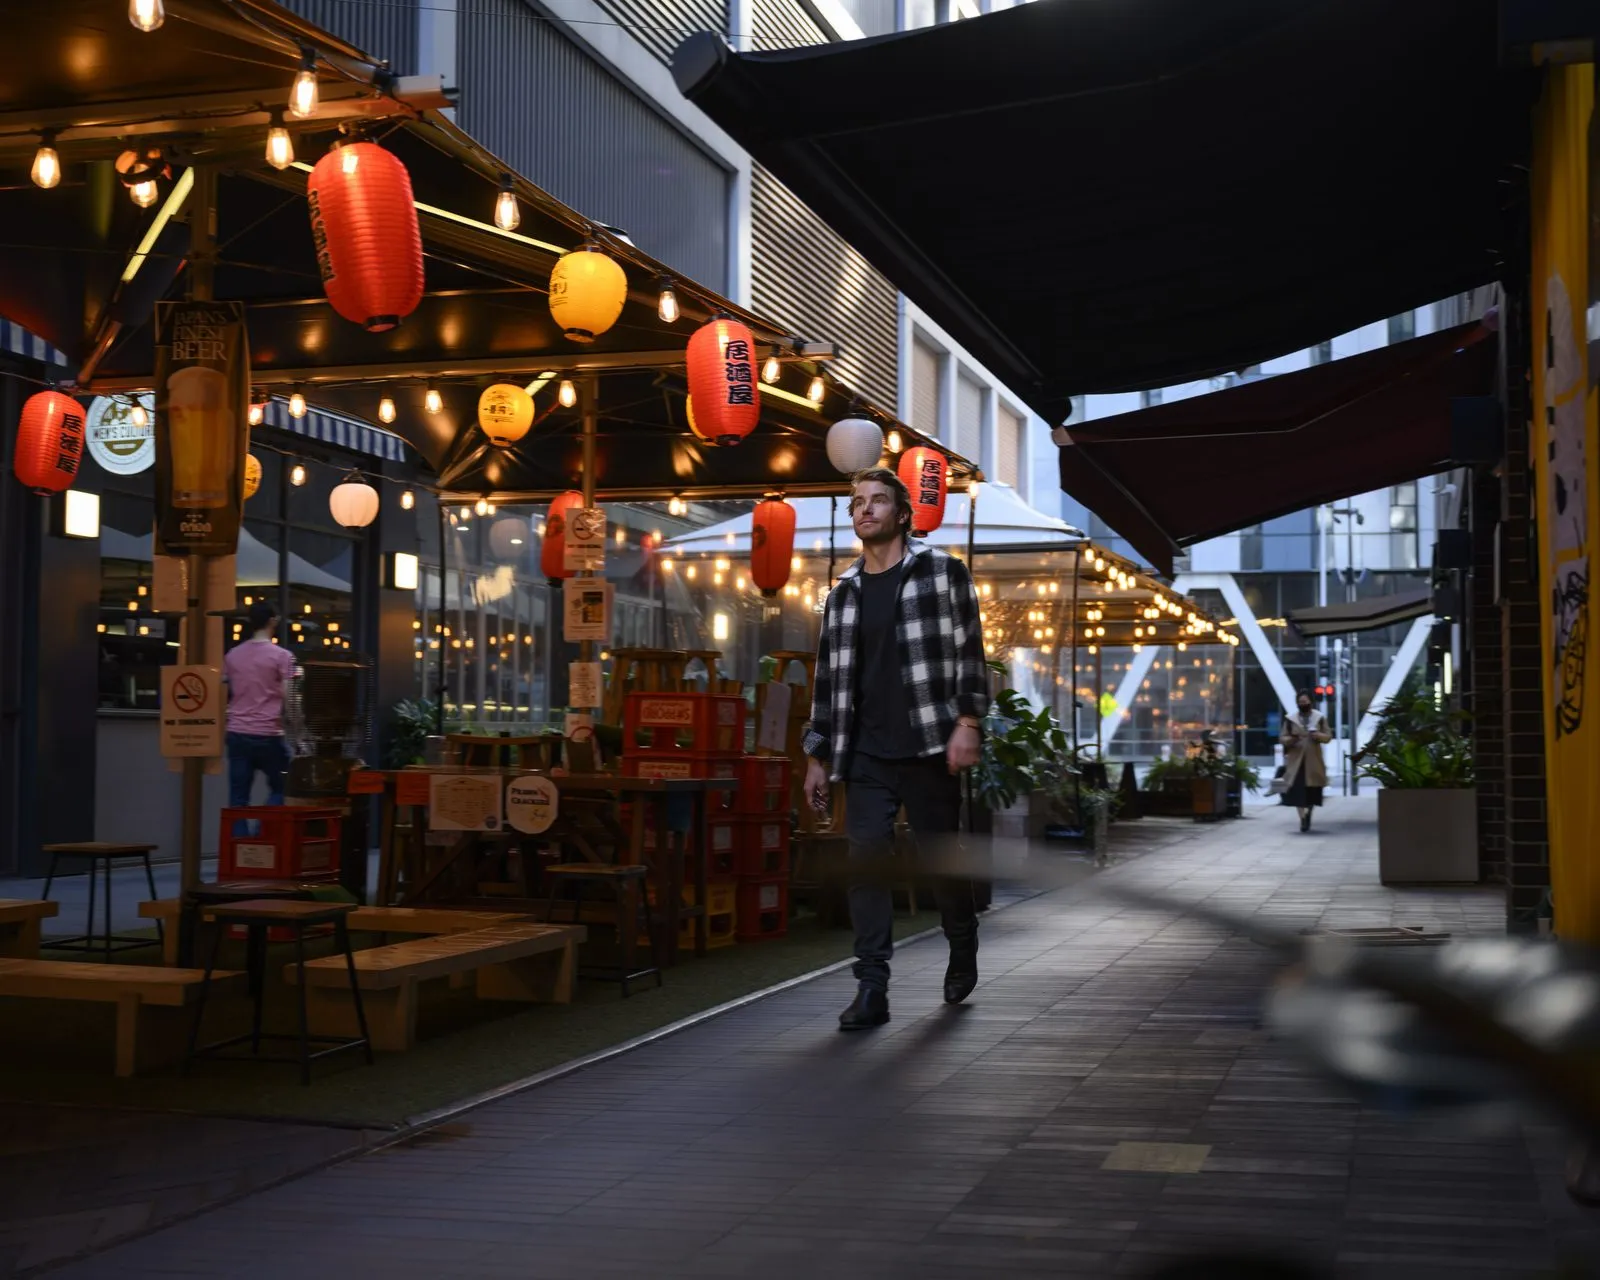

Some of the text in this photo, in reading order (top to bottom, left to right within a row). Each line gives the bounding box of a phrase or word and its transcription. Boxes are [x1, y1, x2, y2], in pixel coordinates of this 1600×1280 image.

[174, 311, 227, 324] JAPAN'S
[172, 325, 228, 341] FINEST
[171, 340, 228, 361] BEER
[724, 340, 754, 405] 居酒屋
